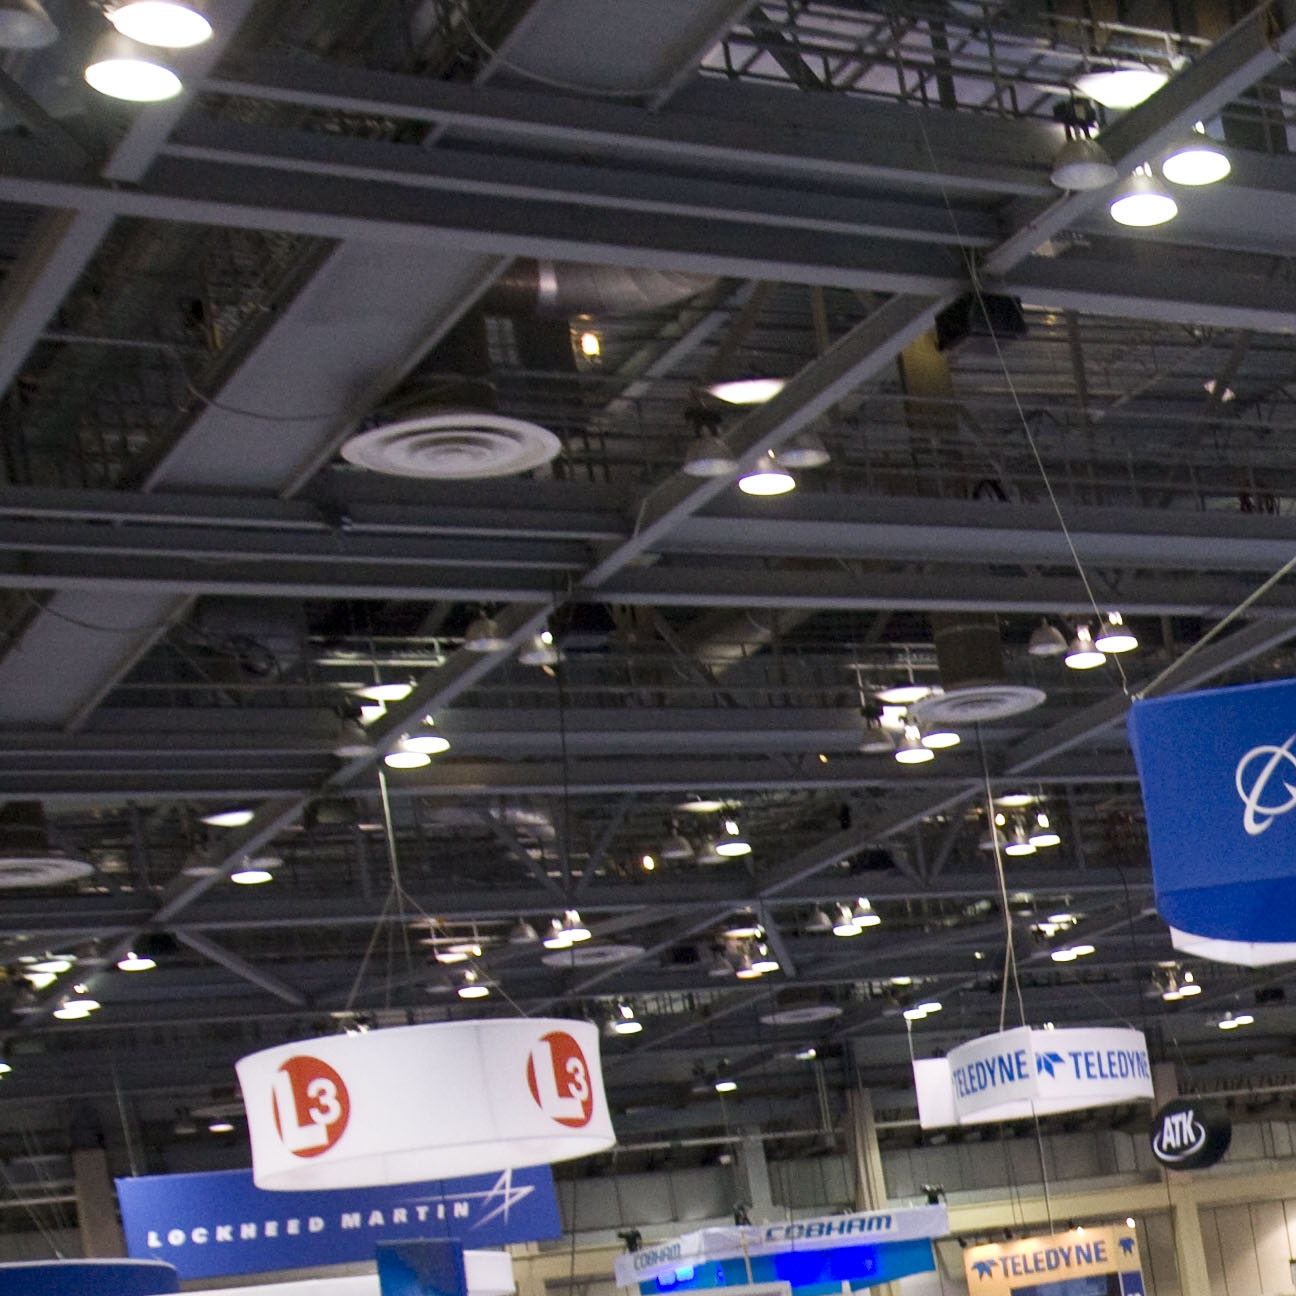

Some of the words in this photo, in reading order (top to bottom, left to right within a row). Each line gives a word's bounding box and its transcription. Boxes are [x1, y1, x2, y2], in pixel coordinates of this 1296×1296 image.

[952, 1049, 1030, 1099] TELEDYNE
[1068, 1049, 1150, 1080] TELEDYNE
[1161, 1109, 1197, 1151] ATK
[146, 1215, 326, 1249] LOCKHEED
[340, 1200, 470, 1230] MARTIN
[763, 1214, 893, 1242] COBHAM
[633, 1243, 682, 1271] COBHAM
[999, 1239, 1108, 1278] TELEDYNE
